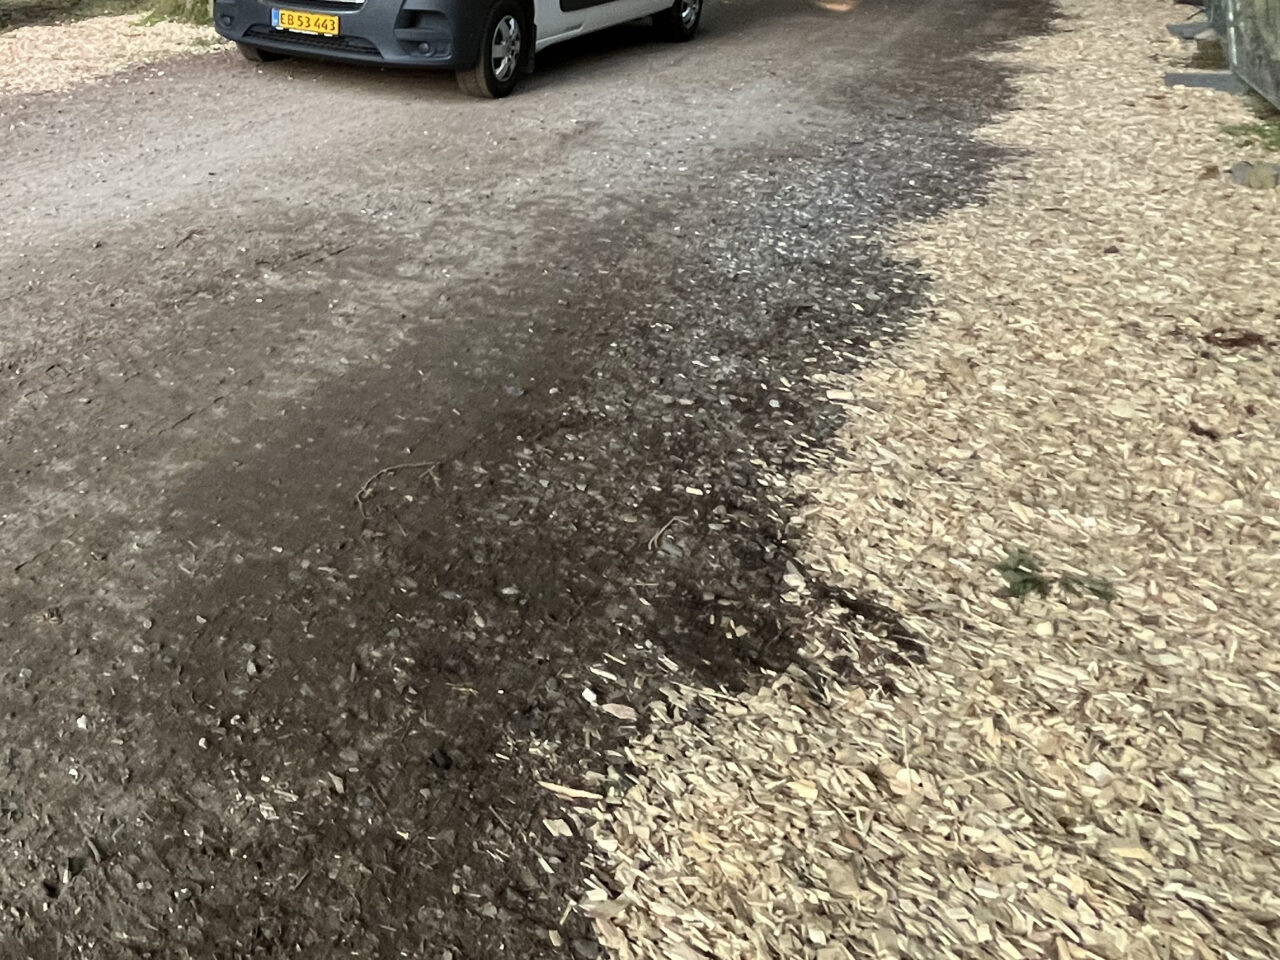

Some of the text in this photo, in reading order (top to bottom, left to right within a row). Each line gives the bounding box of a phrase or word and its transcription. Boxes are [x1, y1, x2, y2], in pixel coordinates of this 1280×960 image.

[280, 13, 336, 31] EB 53 443
